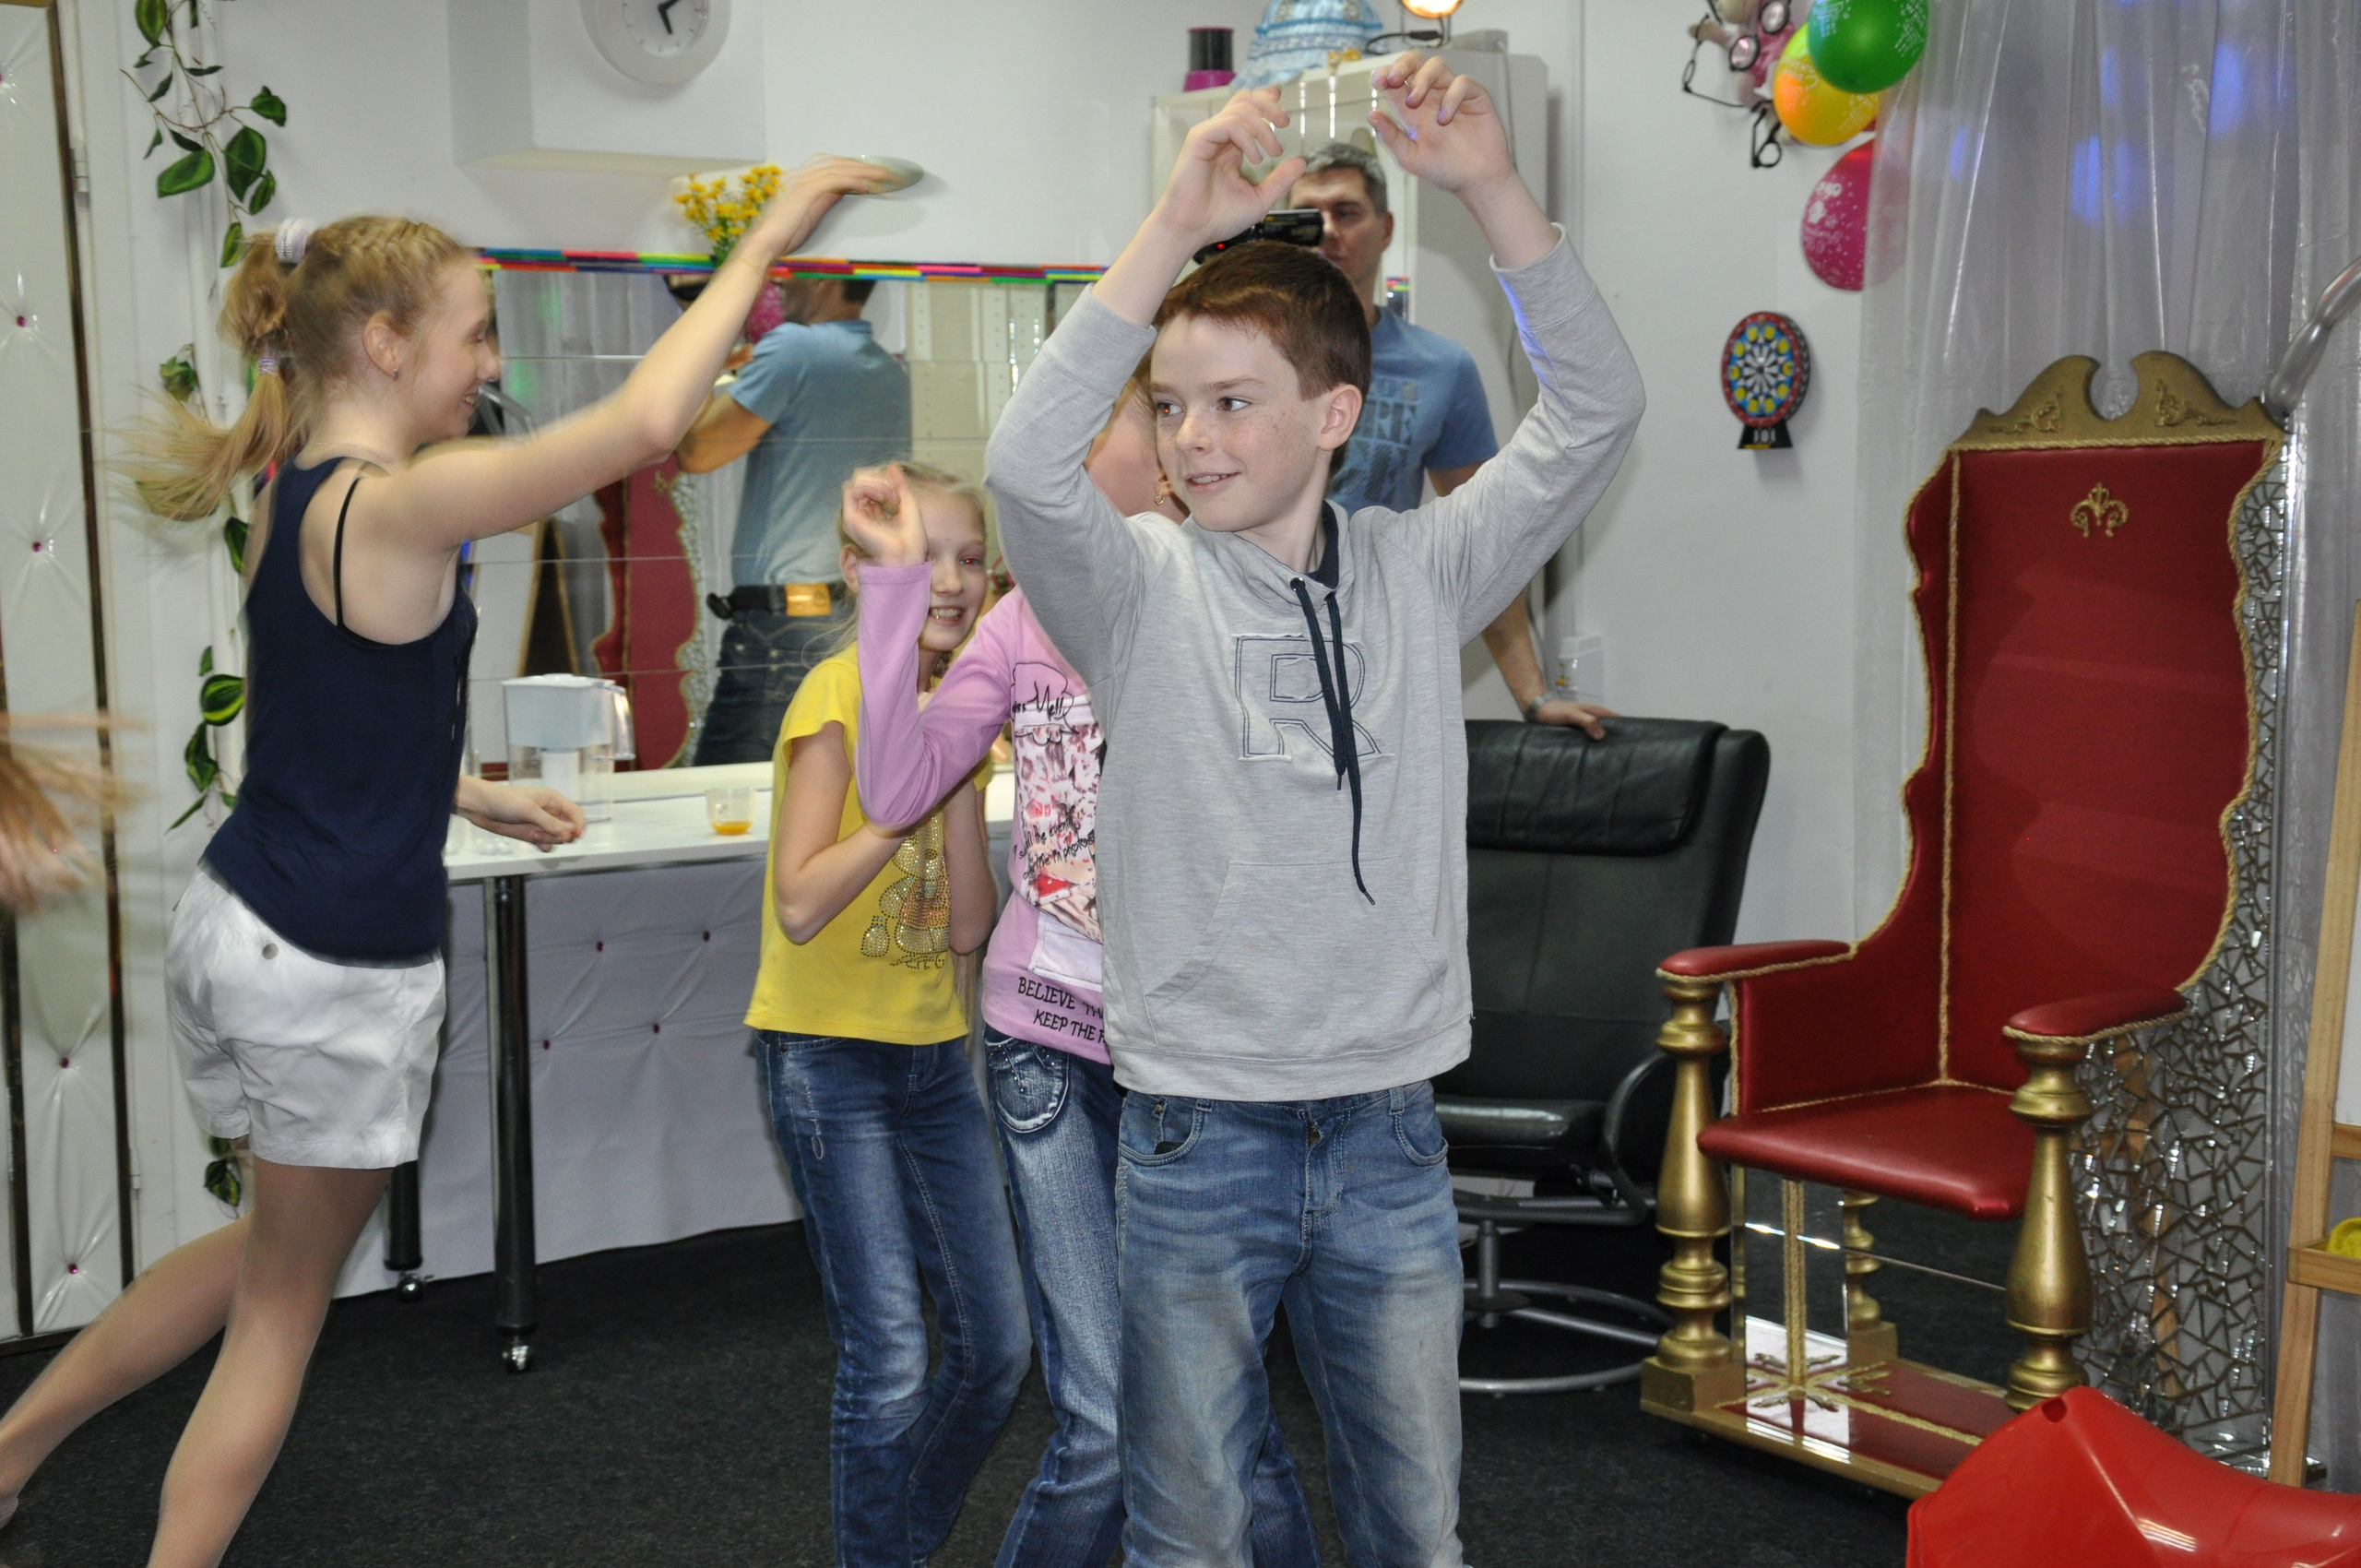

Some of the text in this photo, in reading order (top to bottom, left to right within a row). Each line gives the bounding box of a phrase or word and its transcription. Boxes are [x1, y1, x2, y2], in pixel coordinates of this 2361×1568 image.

[1234, 636, 1382, 759] R
[1018, 976, 1104, 1020] BELIEVE TH
[1033, 1008, 1069, 1032] KEEP
[1070, 1020, 1097, 1041] THE
